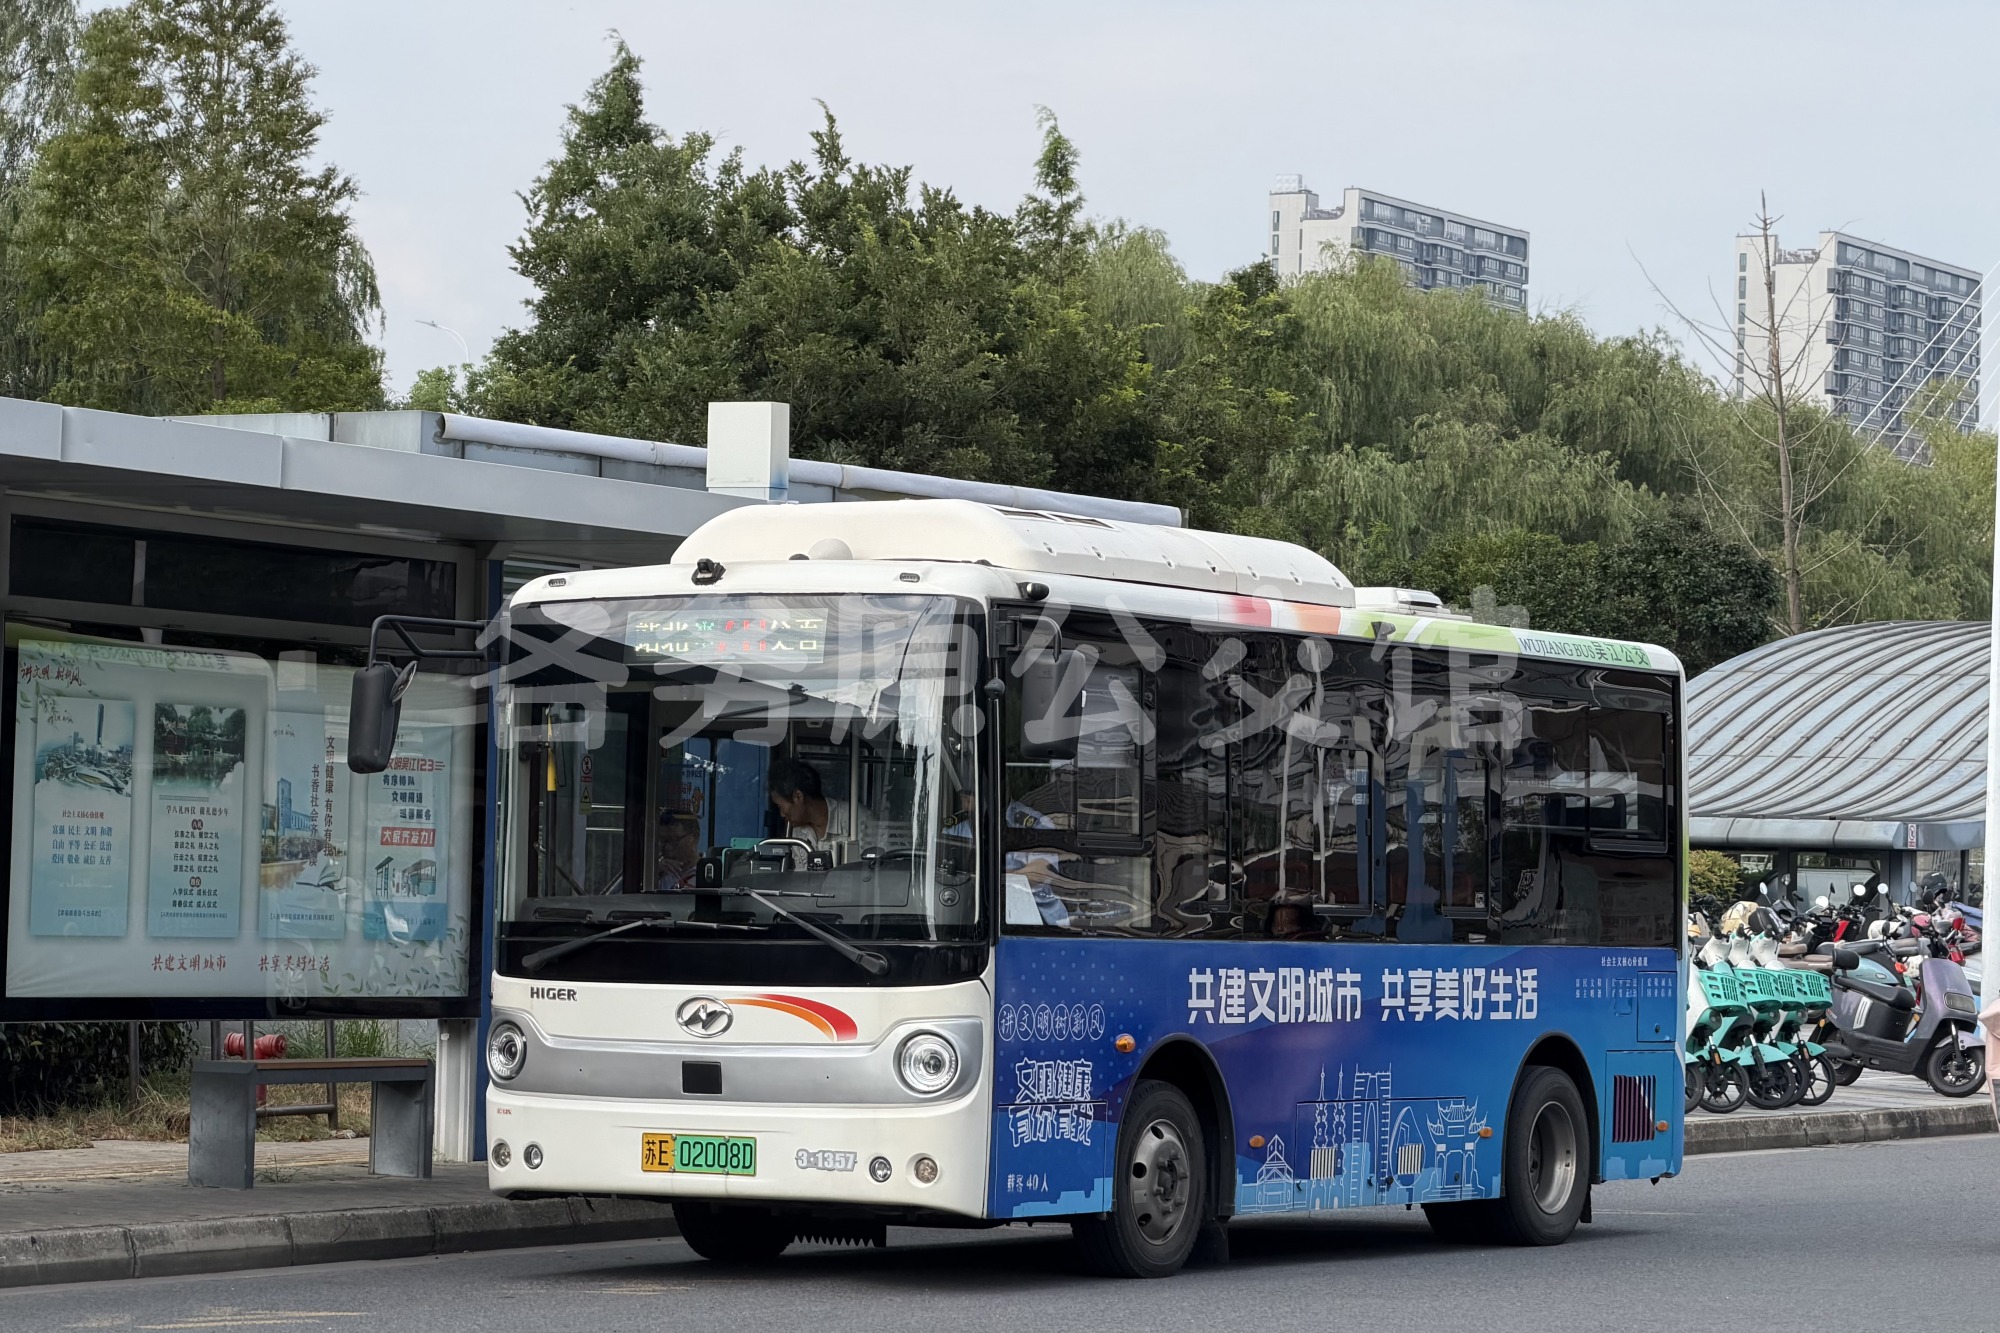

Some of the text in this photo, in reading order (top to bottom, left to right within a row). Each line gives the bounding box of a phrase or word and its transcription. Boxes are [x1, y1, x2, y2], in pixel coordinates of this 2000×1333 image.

[1592, 641, 1649, 665] 吴江公交
[325, 735, 335, 794] 文明健康
[151, 953, 330, 972] 共建文明城市 共享美好生活
[1601, 956, 1648, 967] 社会主义核心价值观
[530, 986, 577, 1001] HIGER
[1188, 967, 1538, 1024] 共建文明城市 共享美好生活
[999, 1006, 1104, 1038] 讲文明树新风
[1015, 1057, 1093, 1101] 文明健康
[1009, 1099, 1094, 1147] 有你有我
